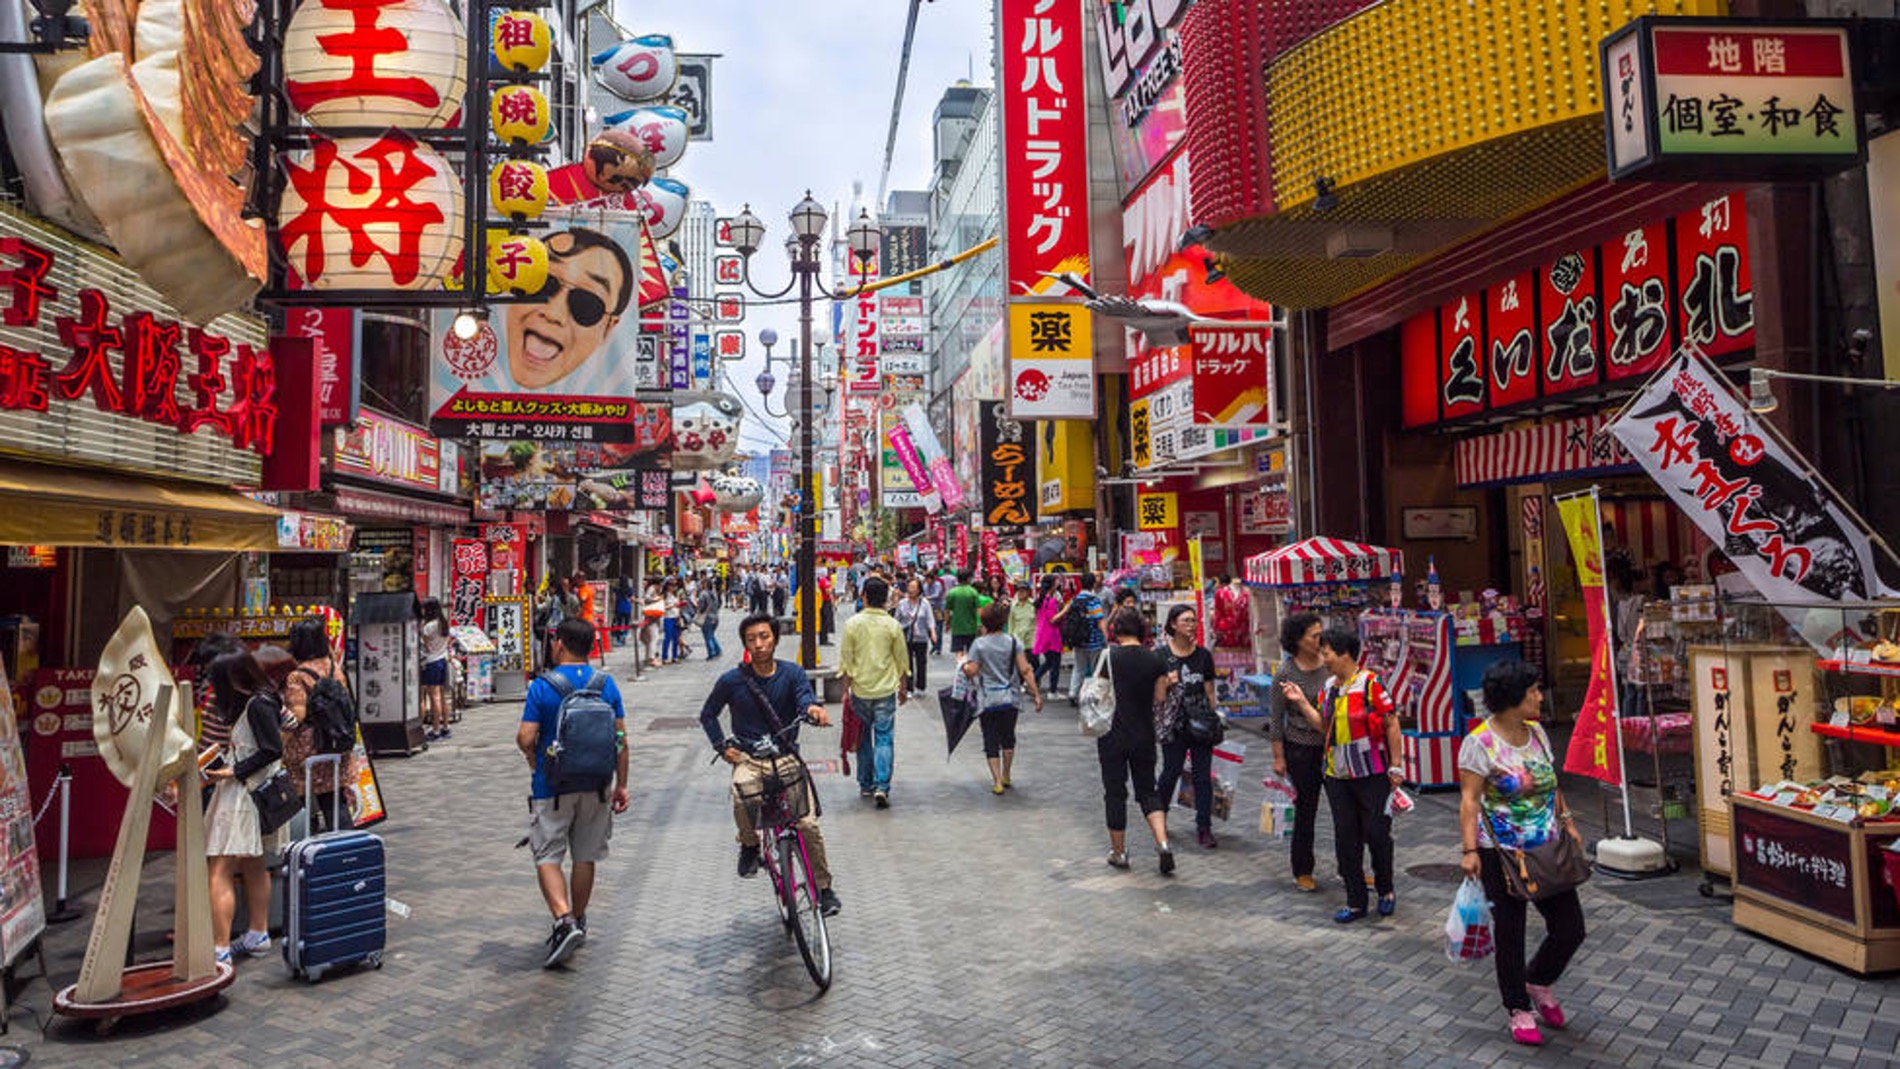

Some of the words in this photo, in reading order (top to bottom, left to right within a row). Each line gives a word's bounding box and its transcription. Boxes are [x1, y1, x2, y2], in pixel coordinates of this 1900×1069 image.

[1707, 37, 1786, 73] 地階
[1019, 0, 1070, 254] ルハドラッグ
[1662, 93, 1844, 138] 個室・和食
[1194, 332, 1264, 354] ツルハ
[1445, 246, 1755, 405] くいだおれ
[55, 289, 279, 457] 大阪王将
[1195, 359, 1251, 375] ドラッグ
[1672, 371, 1741, 437] 熊野産
[988, 443, 1031, 525] らーめん
[1650, 416, 1812, 587] 本まぐろ
[1776, 690, 1798, 780] がんこ寿
